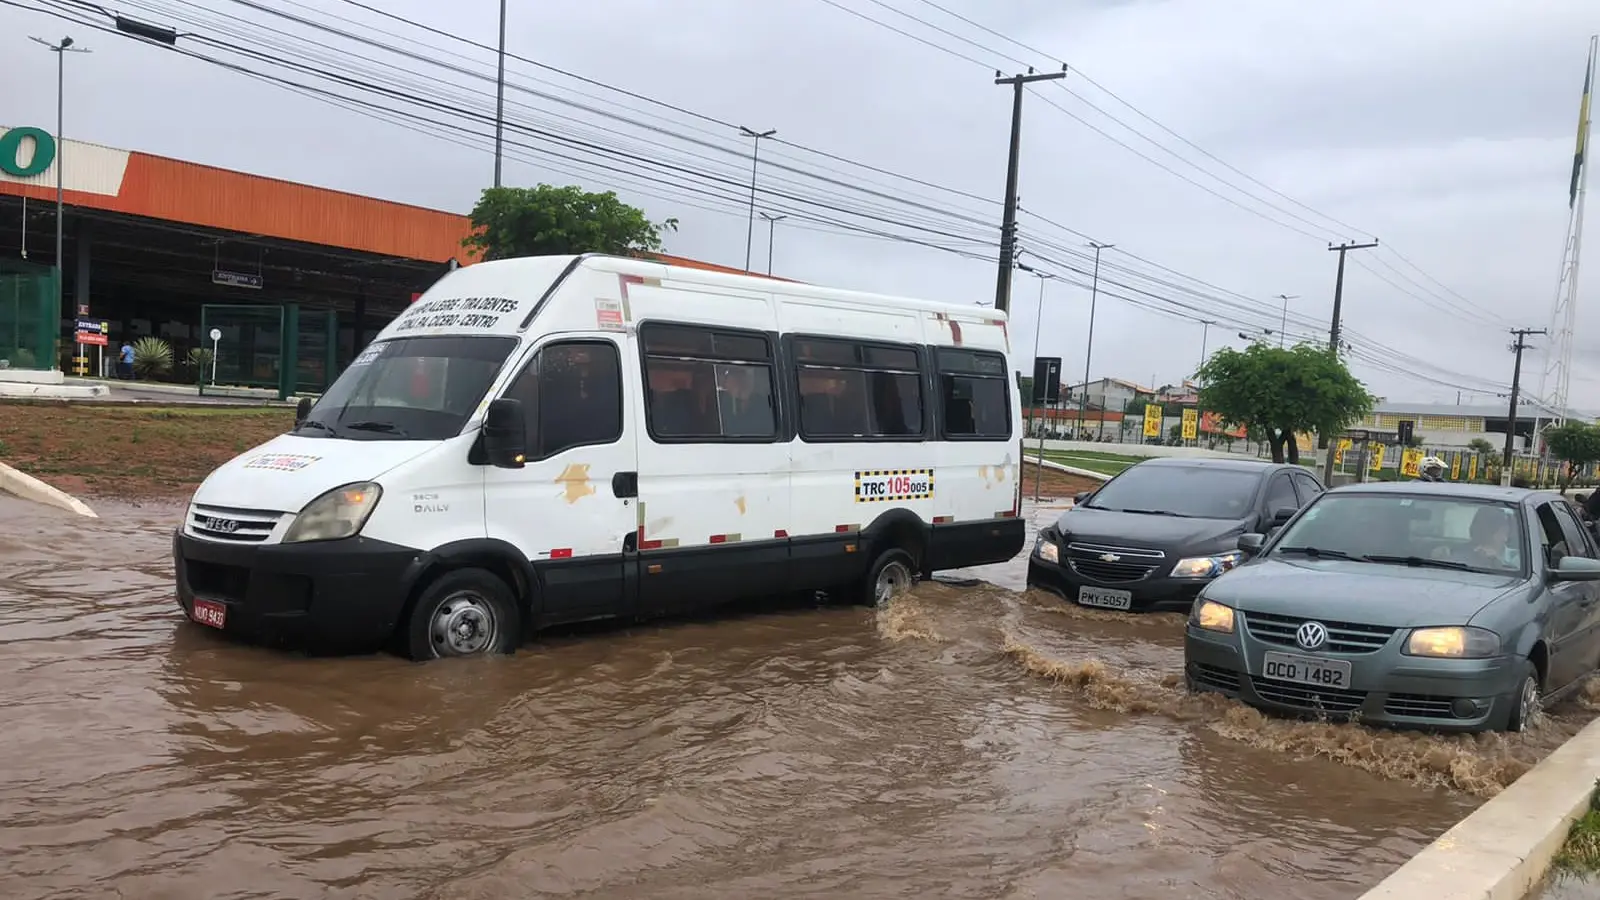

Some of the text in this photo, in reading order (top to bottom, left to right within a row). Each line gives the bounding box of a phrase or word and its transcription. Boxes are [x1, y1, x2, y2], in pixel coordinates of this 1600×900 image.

[460, 314, 498, 328] CENTRO
[863, 477, 927, 495] TRC 105 005
[414, 502, 449, 512] DAILY
[205, 516, 237, 531] IVECO
[1081, 592, 1099, 604] PMY
[1103, 595, 1128, 606] 5057
[1304, 666, 1342, 686] 1482
